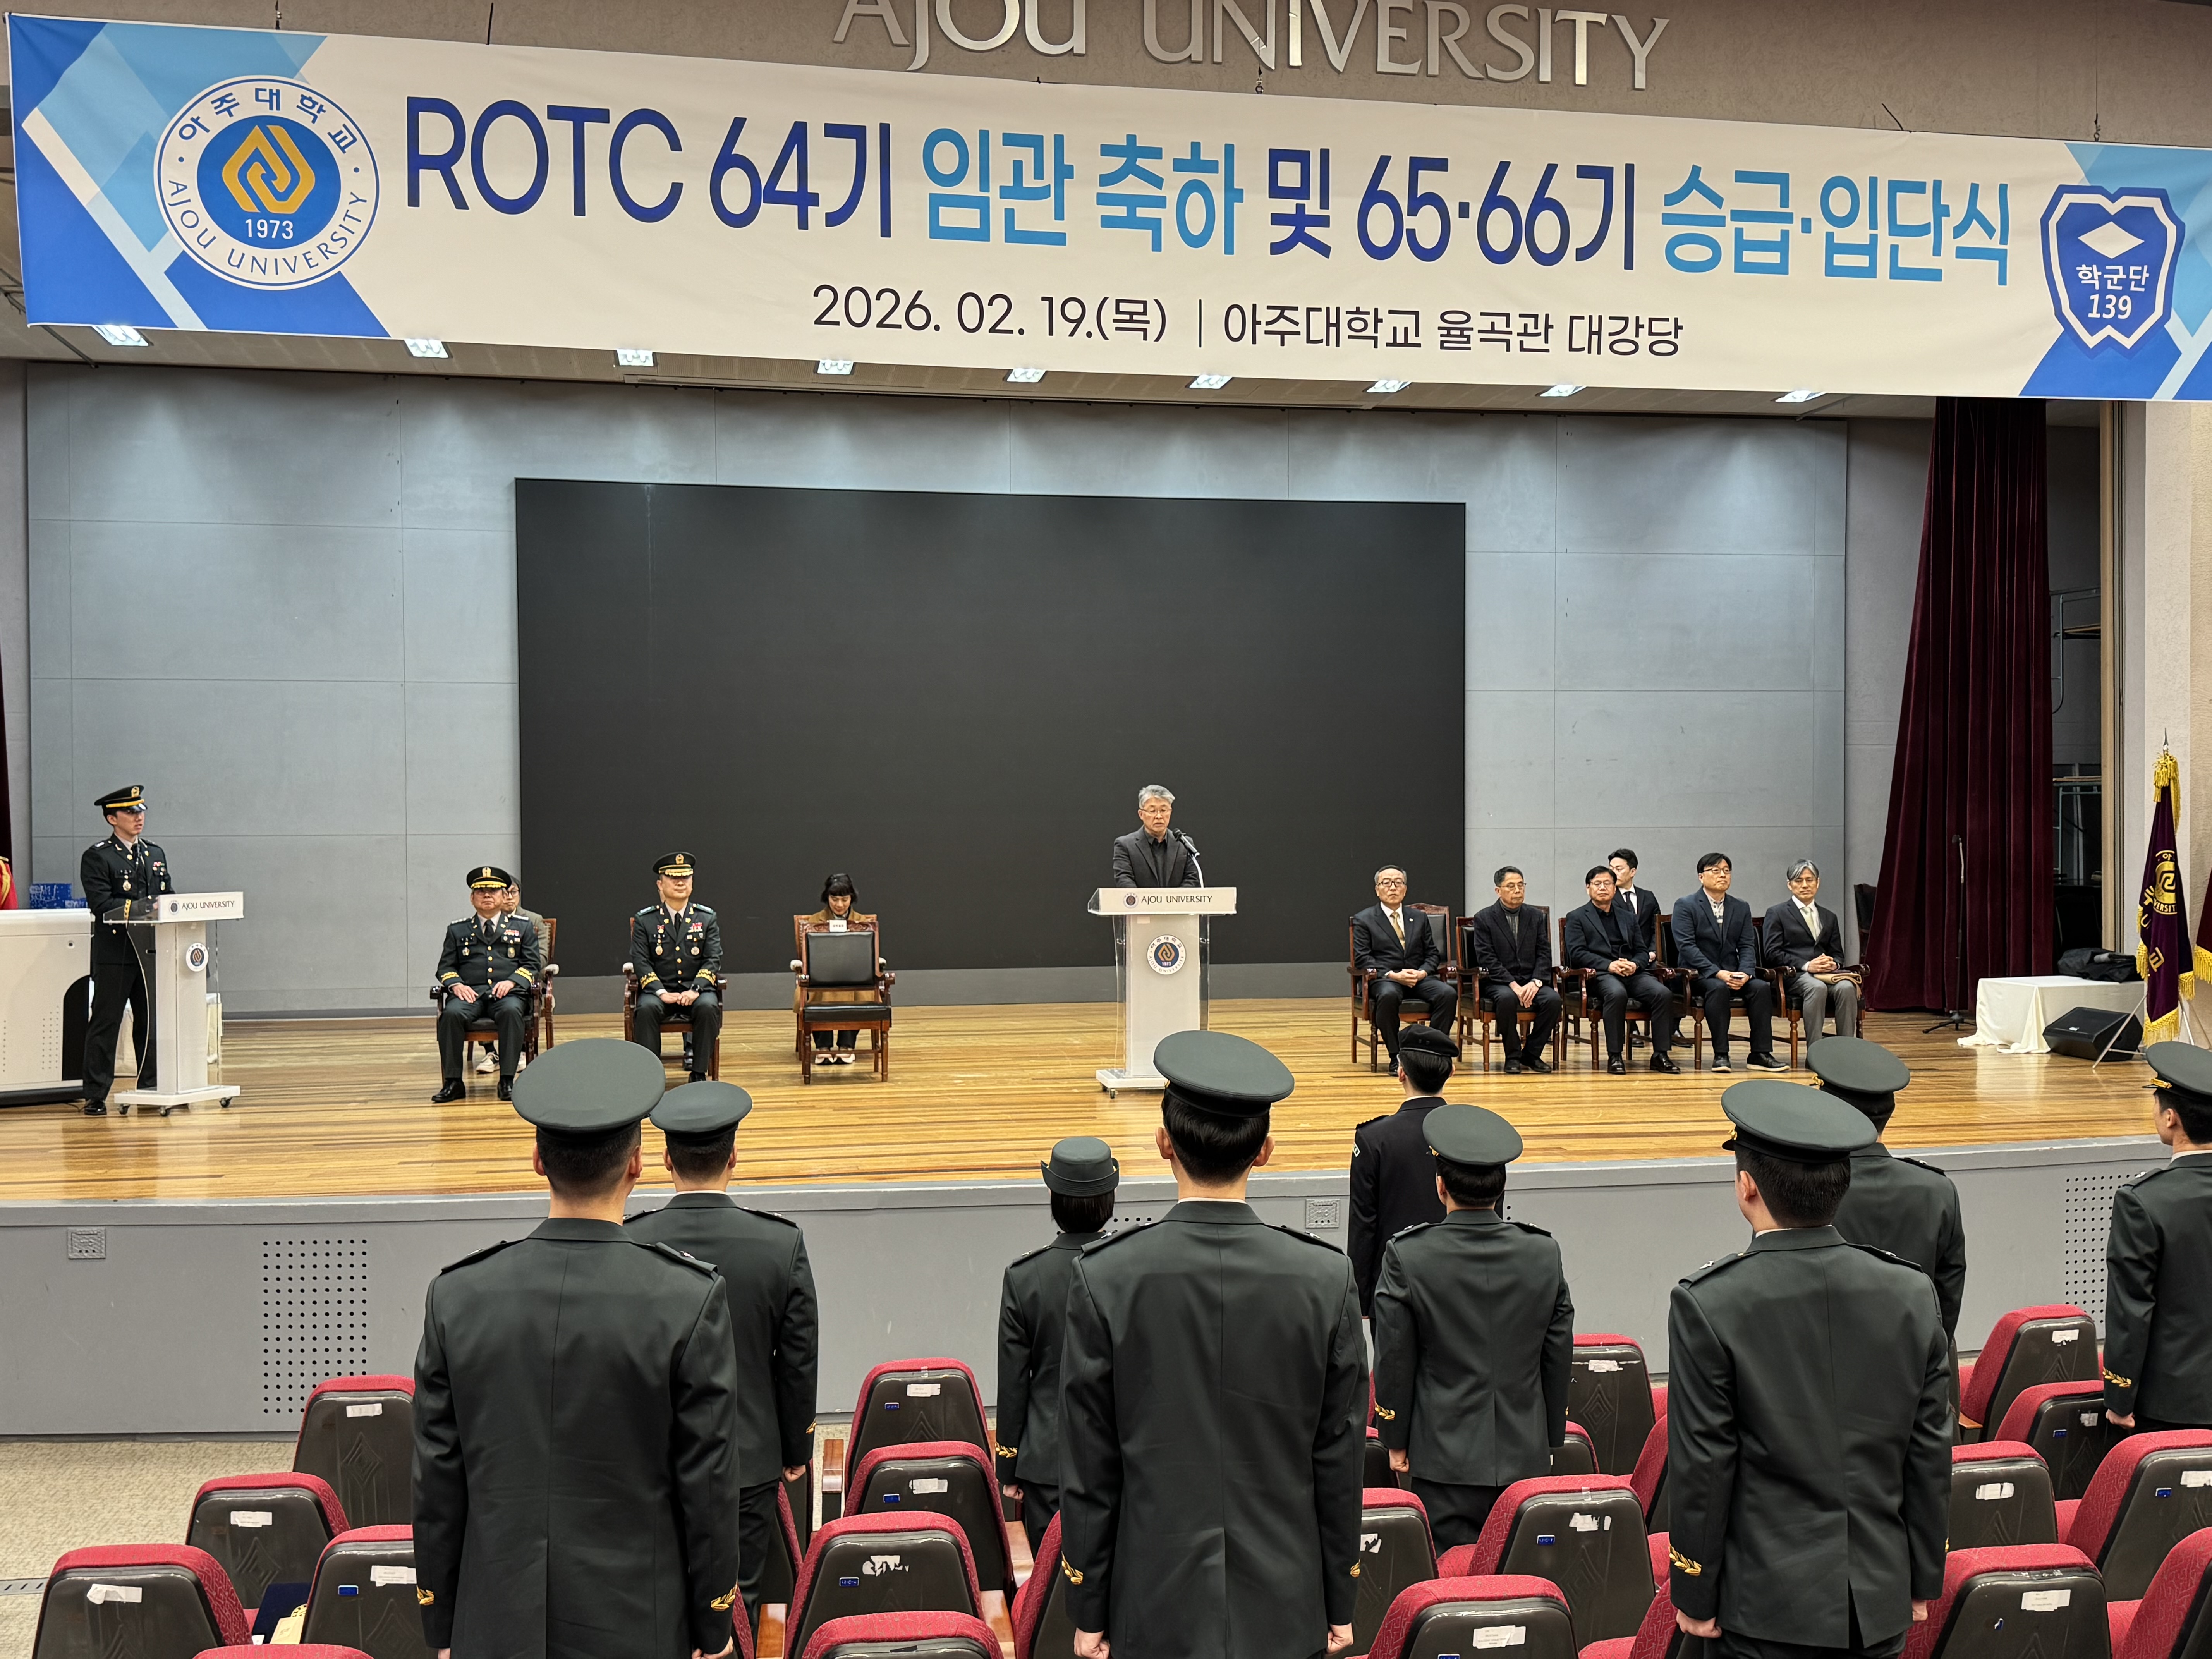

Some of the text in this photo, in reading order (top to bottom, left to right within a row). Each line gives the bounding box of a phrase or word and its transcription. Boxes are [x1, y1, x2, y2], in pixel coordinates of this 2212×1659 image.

[833, 0, 1670, 90] AJOU UNIVERSITY
[178, 87, 359, 154] 아주대학교
[407, 96, 684, 223] ROTC
[709, 117, 891, 238] 64기
[922, 127, 1075, 246] 임관
[1096, 134, 1244, 256] 축하
[1268, 148, 1332, 259] 및
[168, 179, 368, 276] AJOU UNIVERSITY
[244, 218, 294, 240] 1973
[2076, 264, 2150, 293] 학군단
[813, 284, 1684, 357] 2026. 02. 19.(목) 아주대학교 율곡관 대강당
[2087, 294, 2133, 320] 139
[182, 900, 235, 910] AJOU UNIVERSITY
[1141, 896, 1162, 905] AJOU
[2154, 898, 2176, 912] VERSIT
